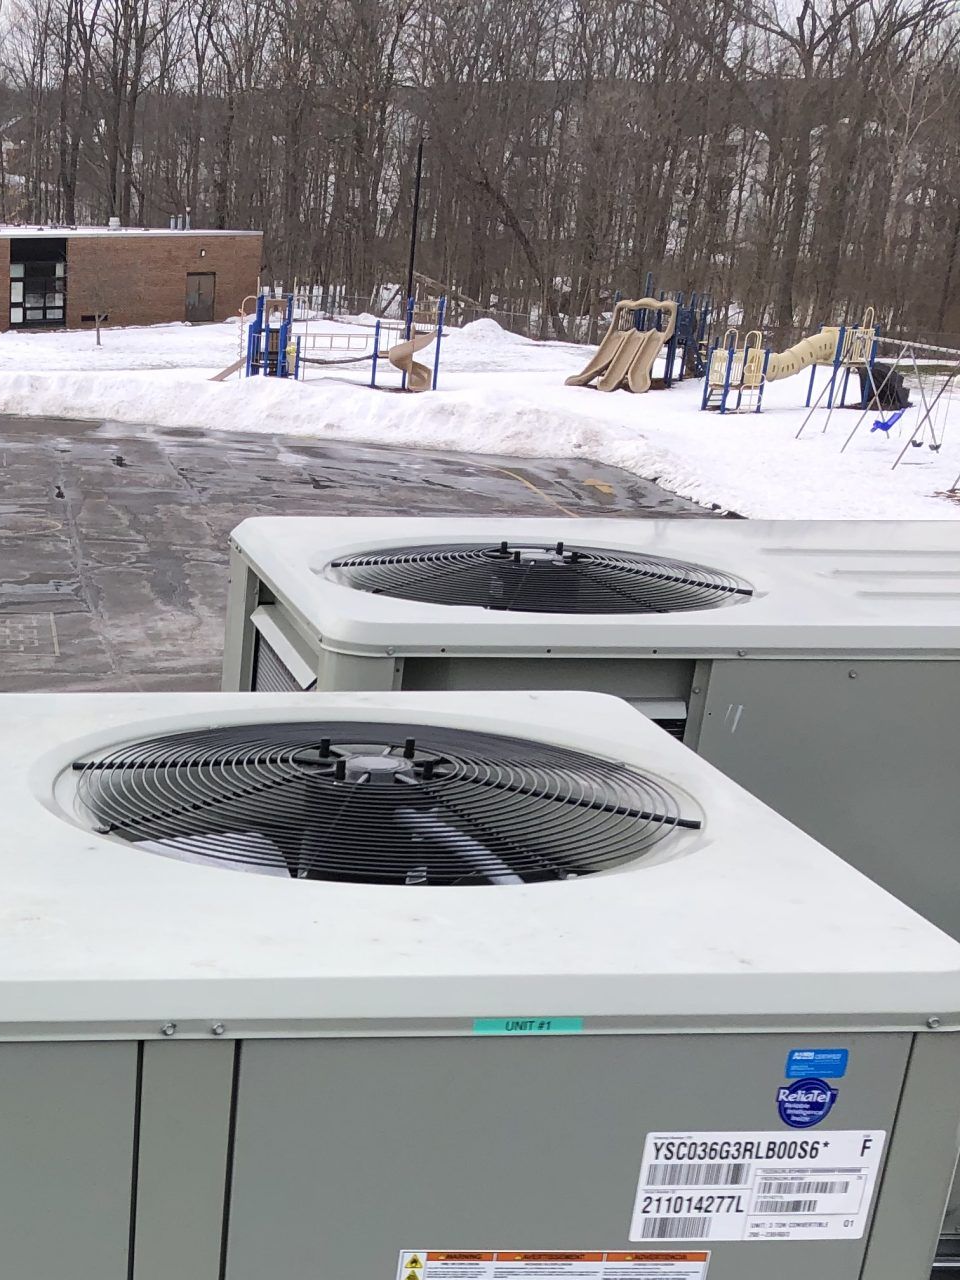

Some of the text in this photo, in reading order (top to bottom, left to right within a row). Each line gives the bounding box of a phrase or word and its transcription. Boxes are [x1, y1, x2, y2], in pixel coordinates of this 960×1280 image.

[505, 1021, 552, 1031] UNIT #1
[779, 1090, 831, 1102] ReliaTel
[860, 1139, 872, 1157] F
[642, 1196, 744, 1213] 211014277L
